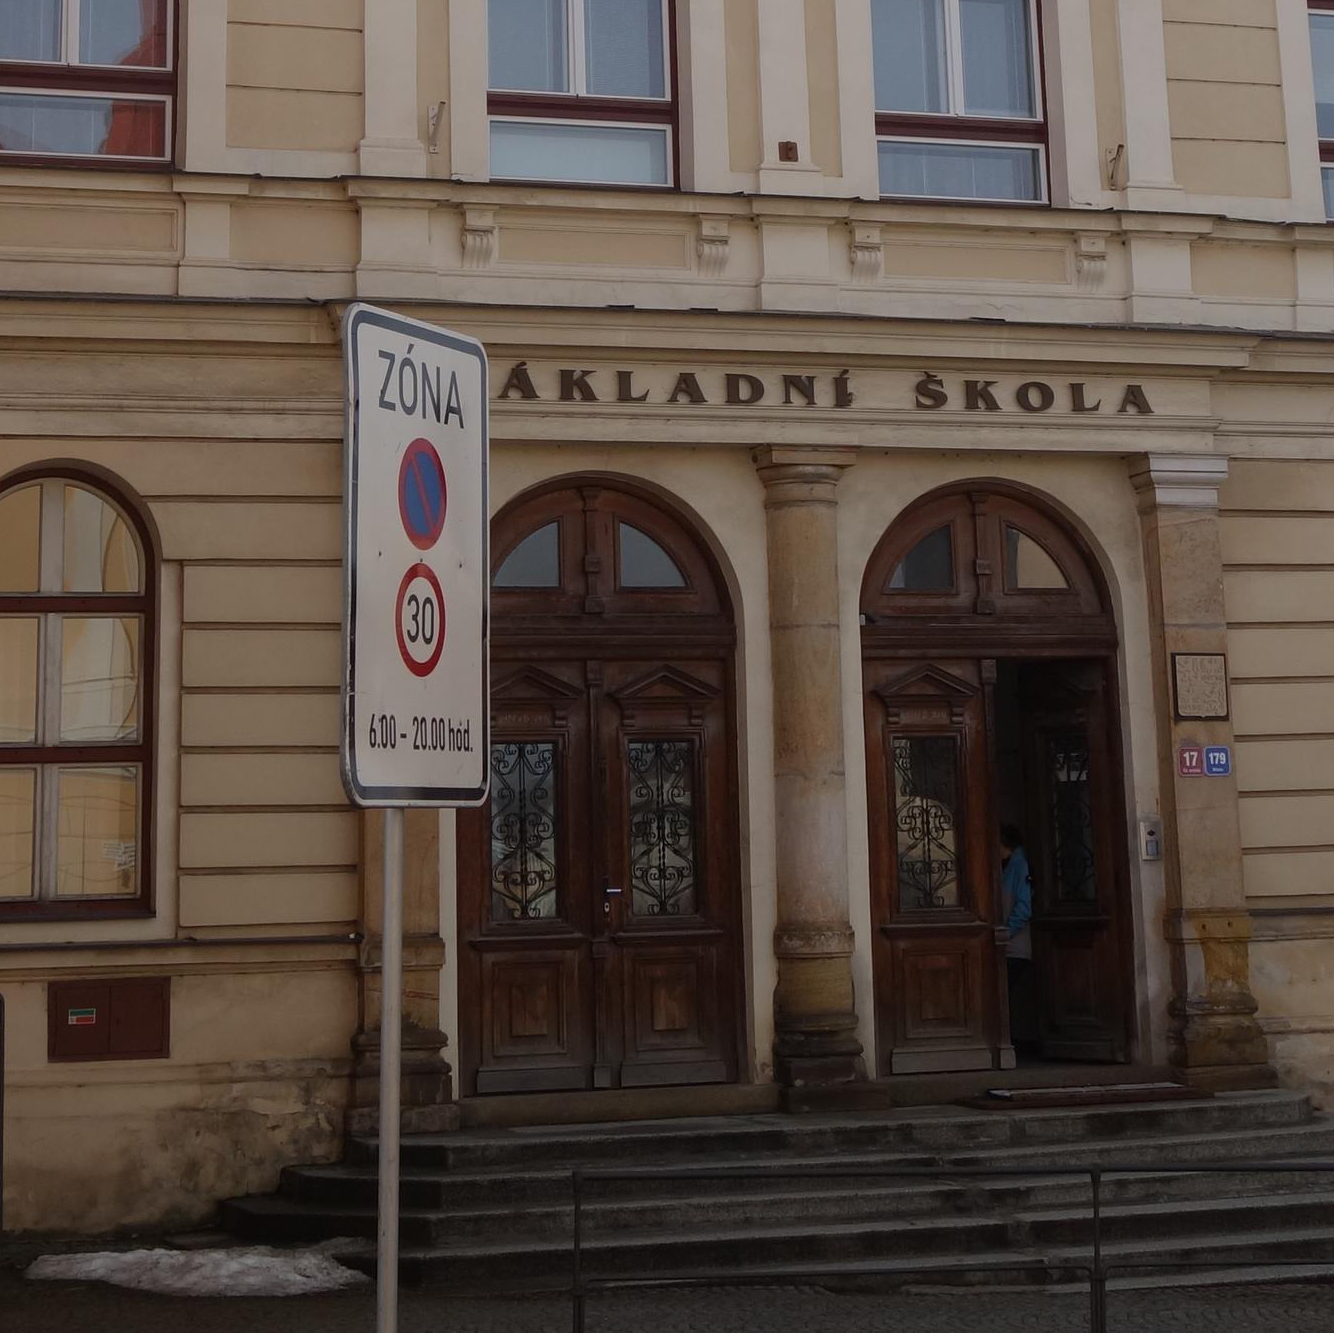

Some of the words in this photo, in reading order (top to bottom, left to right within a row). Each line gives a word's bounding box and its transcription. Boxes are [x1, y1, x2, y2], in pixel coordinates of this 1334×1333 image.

[378, 343, 464, 429] ZÓNA
[497, 361, 853, 407] ÁKLADNÍ
[914, 370, 1155, 413] ŠKOLA
[406, 593, 435, 645] 30
[369, 713, 396, 750] 6.00
[412, 715, 446, 751] 20.00
[448, 718, 474, 752] hod.
[1183, 751, 1198, 767] 17
[1208, 752, 1226, 765] 179
